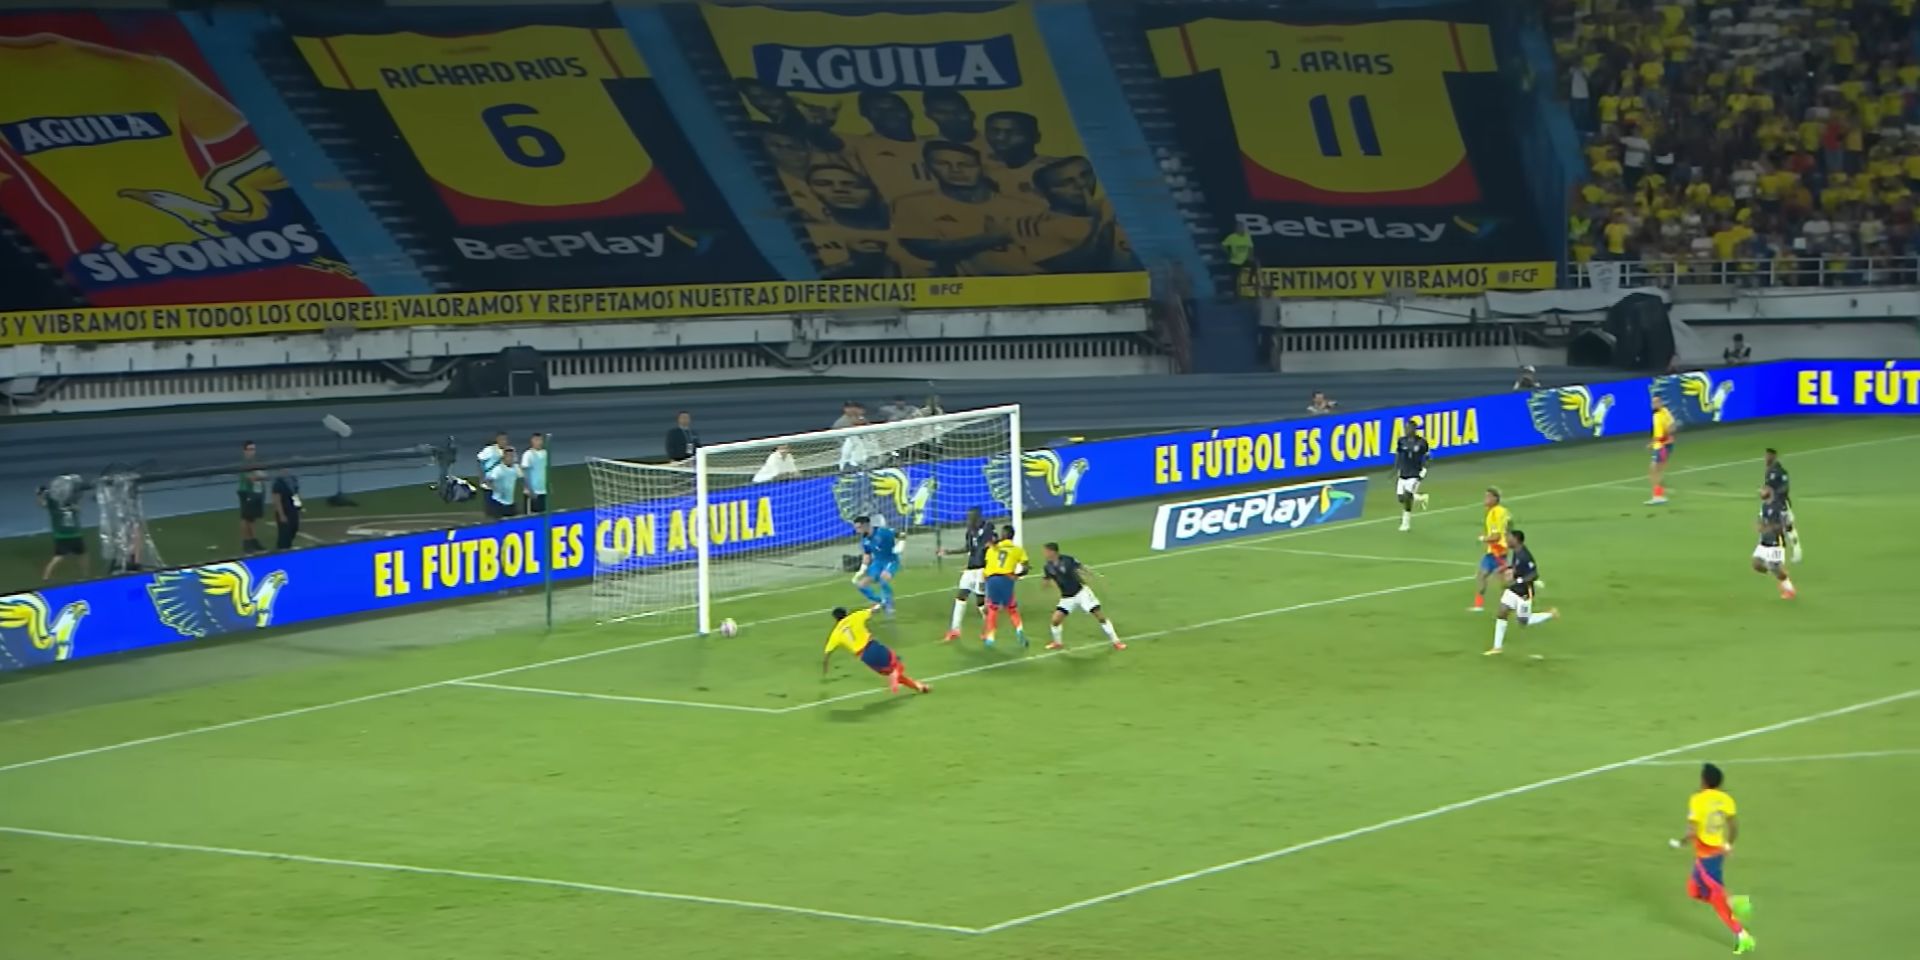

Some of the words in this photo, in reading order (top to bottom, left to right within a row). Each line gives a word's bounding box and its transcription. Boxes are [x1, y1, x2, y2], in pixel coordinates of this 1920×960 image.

[380, 62, 514, 88] RICHARD
[515, 57, 588, 79] RIOS
[776, 44, 1006, 90] AGUILA
[22, 114, 160, 152] AGUILA
[481, 103, 565, 168] 6
[1309, 94, 1382, 157] 11
[453, 231, 665, 260] BetPlay
[1235, 213, 1446, 242] BetPlay
[79, 243, 138, 281] SÍ
[142, 223, 319, 275] SOMOS
[1263, 270, 1358, 291] ENTIMOS
[1363, 271, 1376, 289] Y
[1381, 267, 1488, 288] VIBRAMOS
[13, 316, 26, 337] Y
[32, 310, 147, 335] VIBRAMOS
[153, 308, 181, 329] EN
[186, 306, 253, 328] TODOS
[258, 304, 291, 325] LOS
[296, 300, 388, 323] COLORES!
[392, 294, 523, 321] ¡VALORAMOS
[527, 294, 542, 313] Y
[548, 290, 674, 313] RESPETAMOS
[680, 286, 779, 308] NUESTRAS
[784, 282, 916, 303] DIFERENCIAS!
[1798, 369, 1839, 405] EL
[1854, 360, 1920, 405] FÚT
[1154, 444, 1182, 484] EL
[1191, 428, 1285, 480] FÚTBOL
[1294, 428, 1321, 467] ES
[1330, 419, 1381, 462] CON
[1175, 494, 1319, 539] BetPlay
[374, 550, 410, 597] EL
[422, 528, 541, 591] FÚTBOL
[551, 523, 584, 569] ES
[595, 513, 656, 556] CON
[998, 550, 1008, 569] 9
